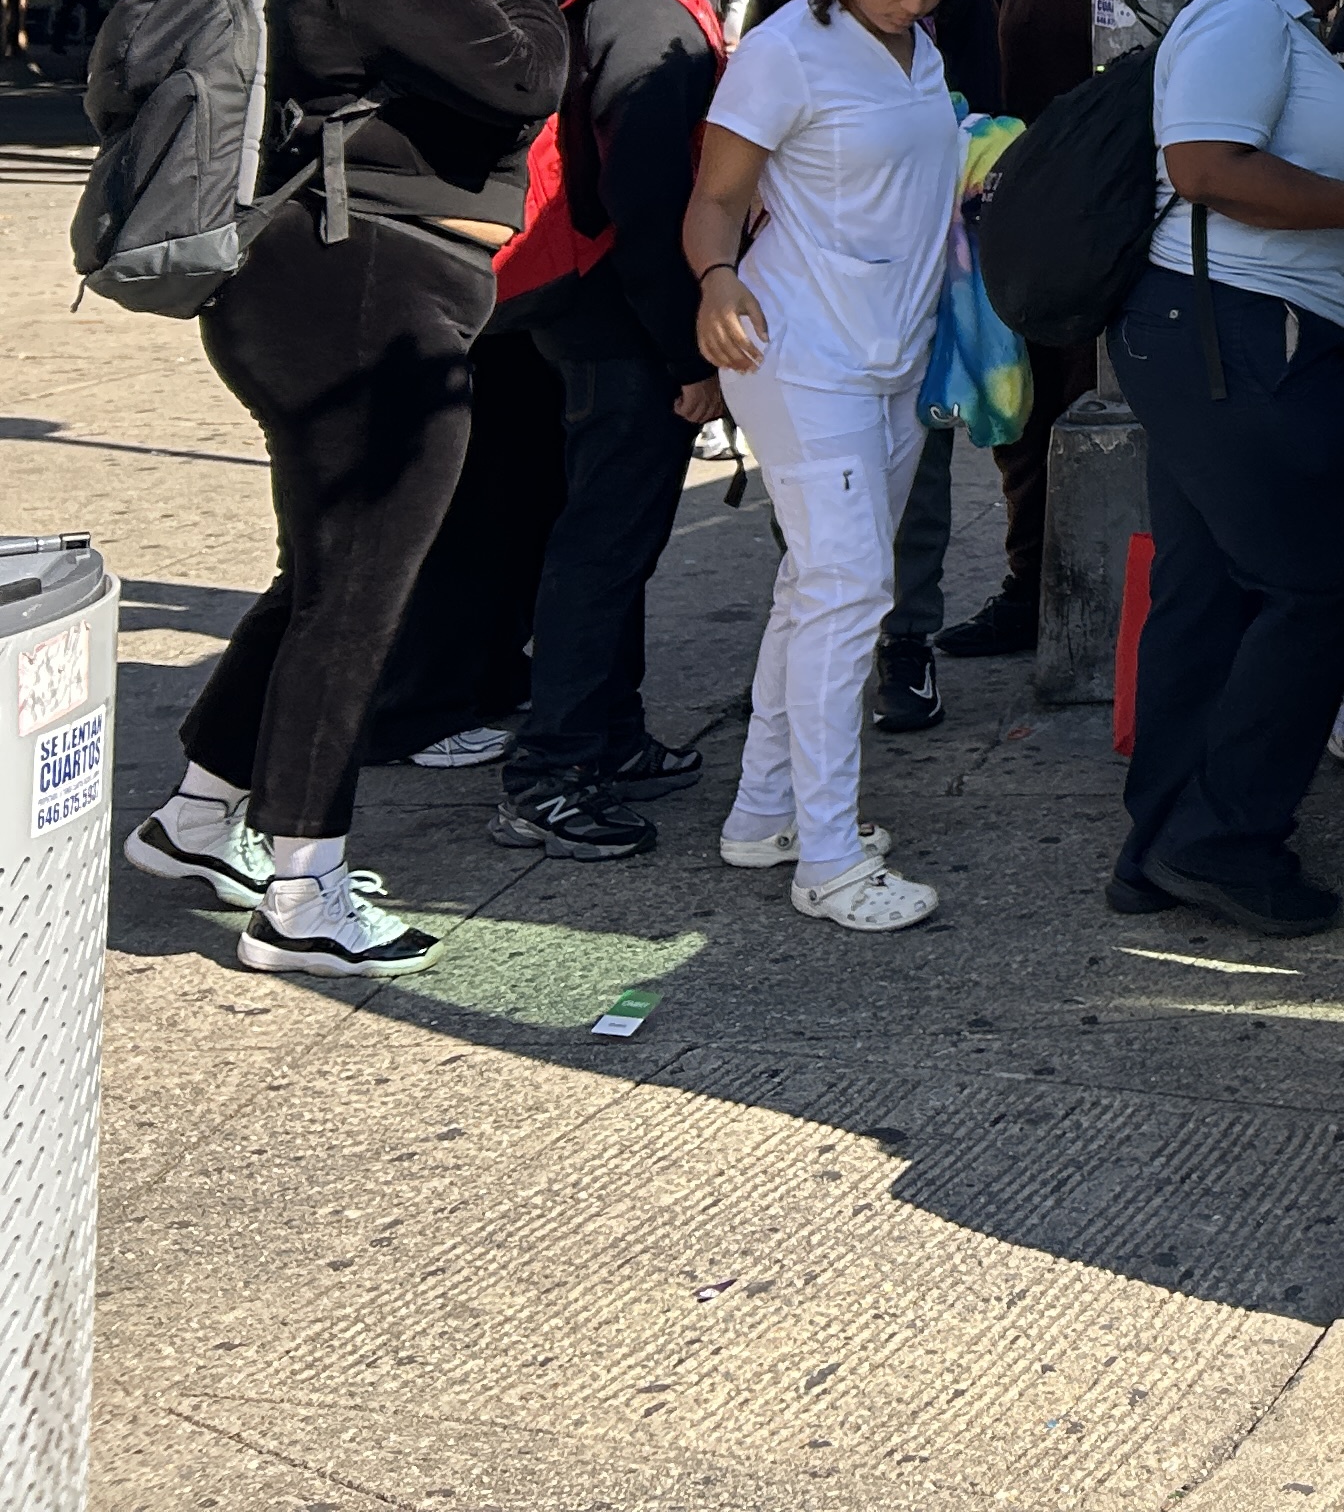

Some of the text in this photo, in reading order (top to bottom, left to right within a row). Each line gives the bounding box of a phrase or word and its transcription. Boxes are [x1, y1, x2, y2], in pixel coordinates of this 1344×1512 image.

[41, 735, 59, 762] SE
[40, 735, 101, 793] CUARTOS
[535, 795, 581, 824] N
